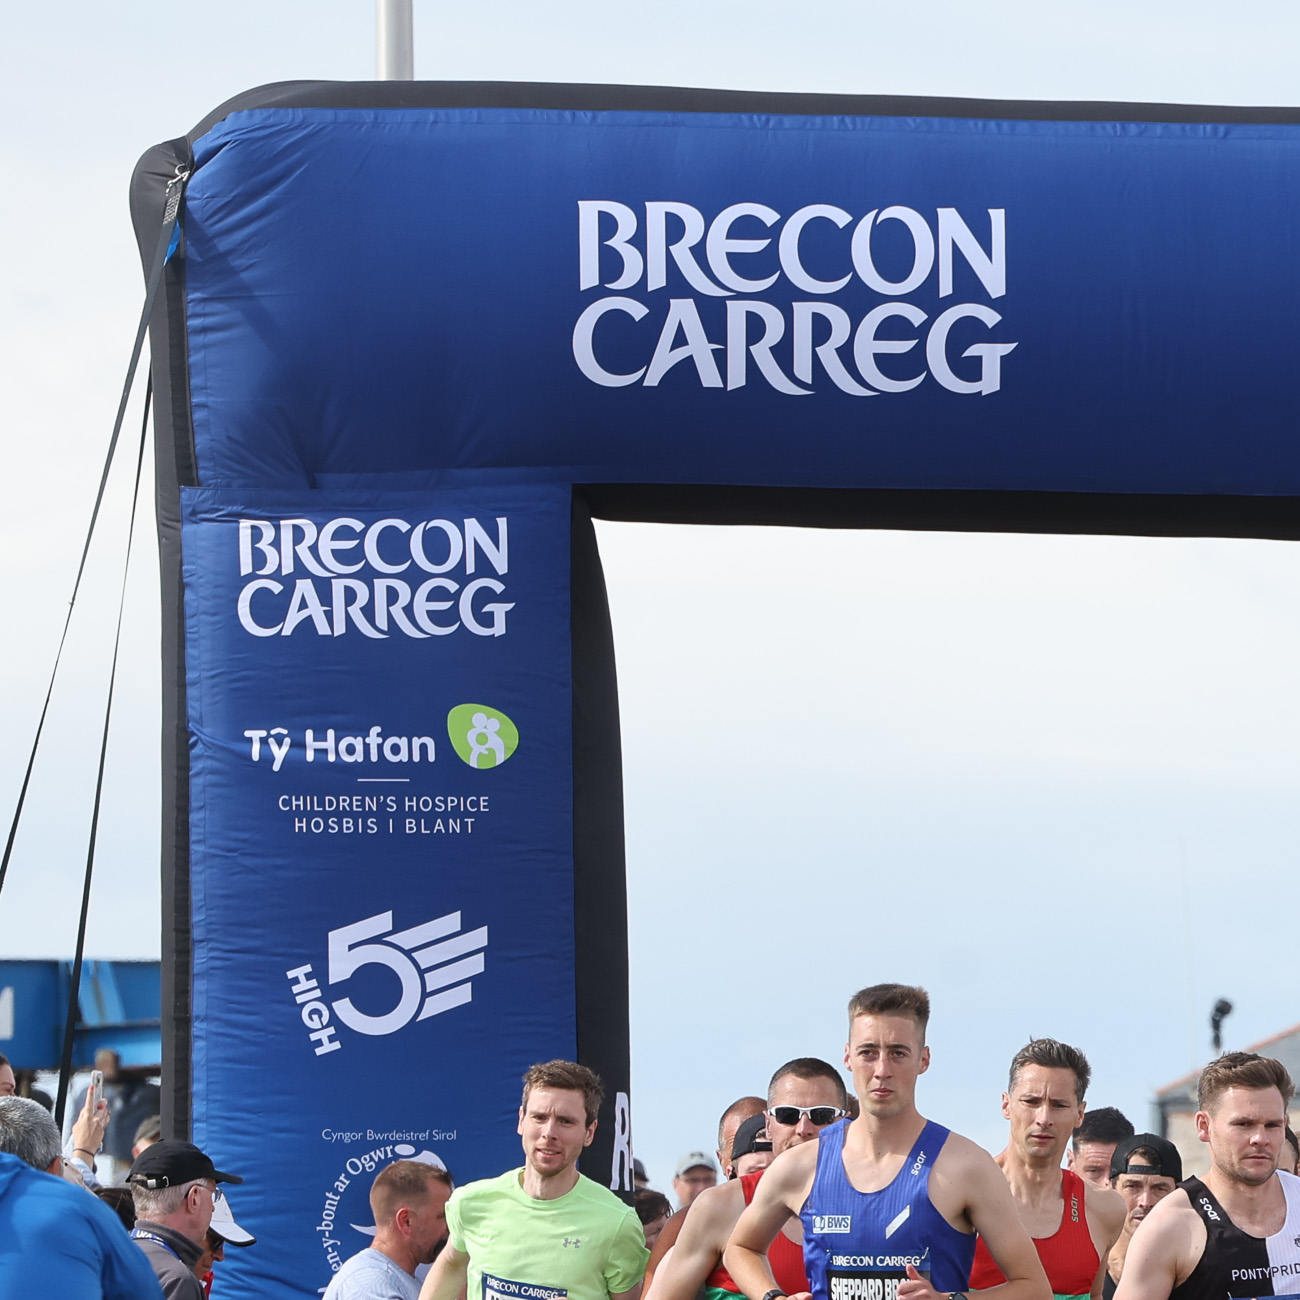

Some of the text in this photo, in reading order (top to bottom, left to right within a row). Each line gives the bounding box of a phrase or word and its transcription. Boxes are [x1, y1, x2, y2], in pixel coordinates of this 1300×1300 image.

[578, 199, 1007, 299] BRECON
[572, 296, 1019, 397] CARREG
[238, 516, 509, 578] BRECON
[236, 577, 516, 639] CARREG
[243, 726, 436, 772] Tŷ Hafan
[404, 795, 490, 813] HOSPICE
[294, 817, 476, 834] HOSBIS I BLANT
[286, 964, 342, 1057] HIGH
[321, 1128, 457, 1143] Cyngor Bwrdeistref Sirol
[911, 1150, 927, 1176] soar
[316, 1144, 394, 1272] en-y-bont ar Ogwr
[1200, 1197, 1221, 1222] soar
[827, 1216, 849, 1229] BWS
[832, 1255, 921, 1267] BRECON CARREG
[487, 1276, 559, 1299] BRECON CARREG
[830, 1277, 883, 1300] SHEPPARD
